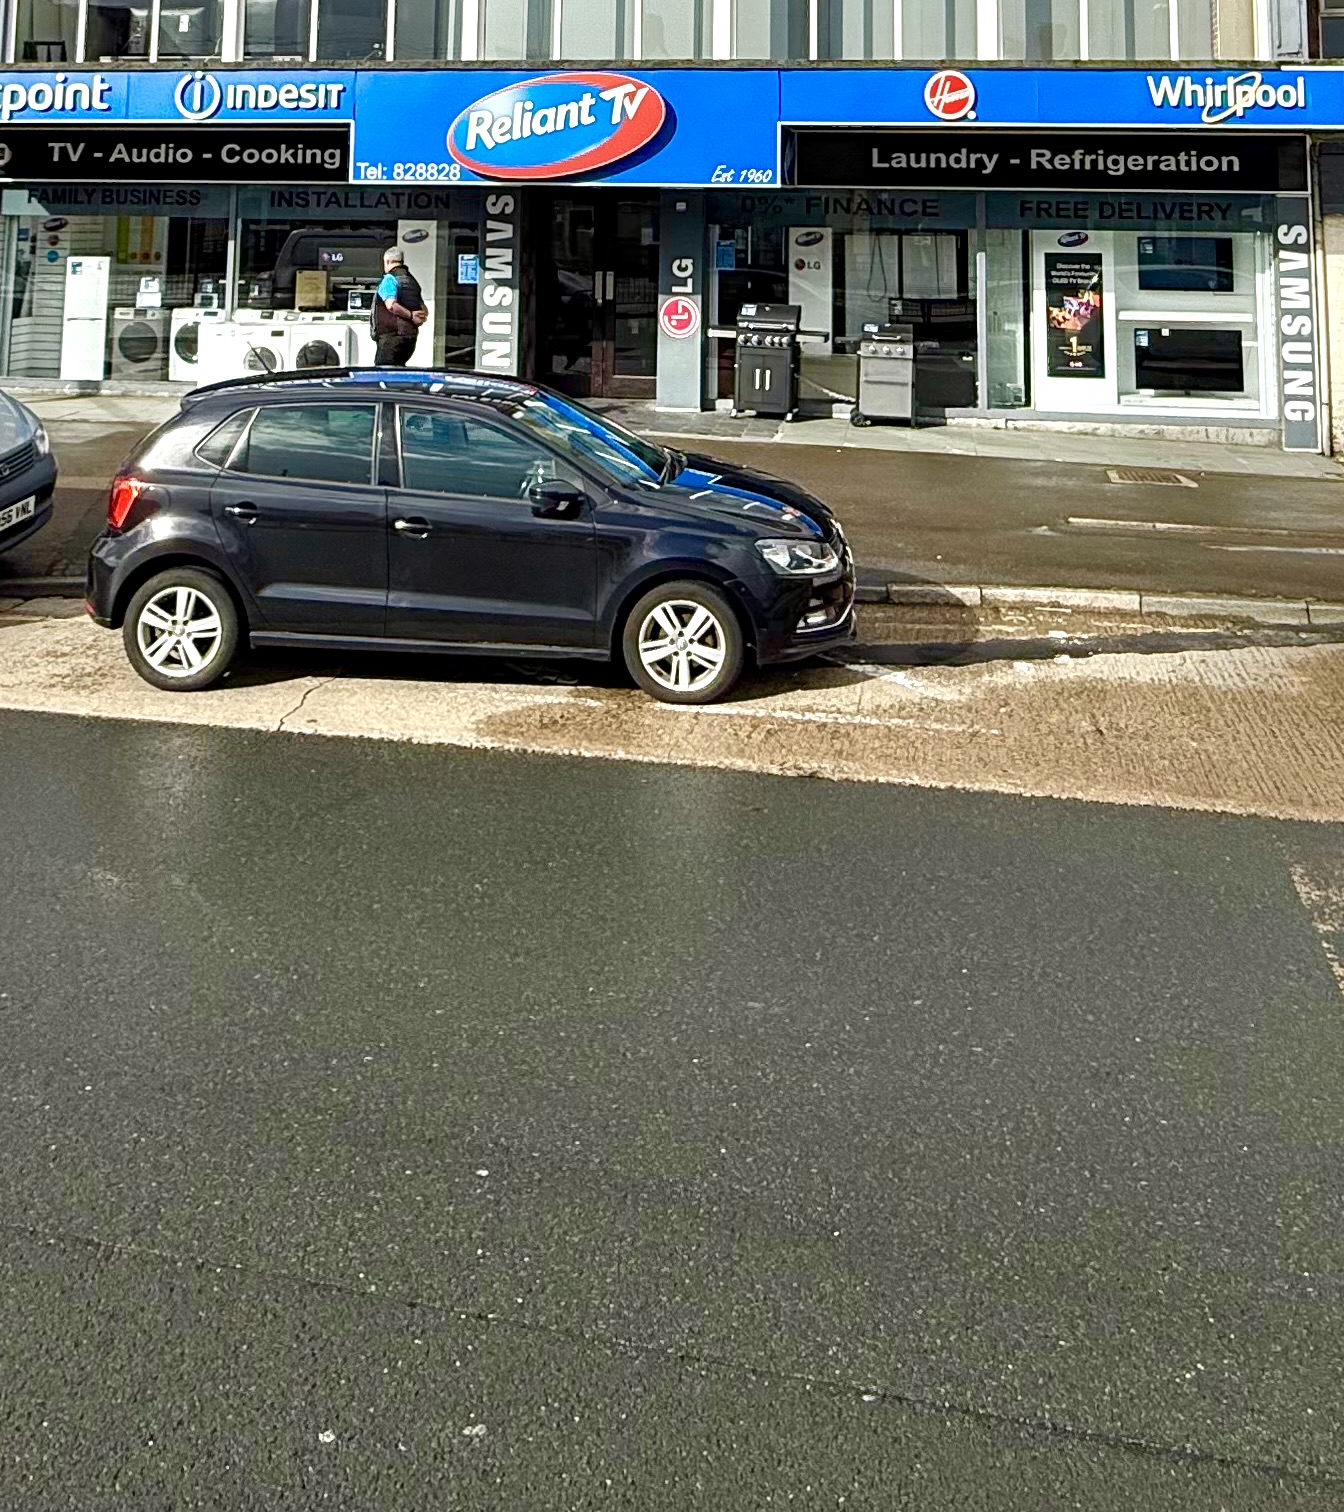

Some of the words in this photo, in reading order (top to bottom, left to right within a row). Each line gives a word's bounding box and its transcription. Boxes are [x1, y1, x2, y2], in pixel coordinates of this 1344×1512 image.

[1146, 74, 1305, 119] Whirlpool
[465, 92, 596, 151] Reliant
[48, 142, 85, 162] TV
[108, 143, 193, 163] Audio
[220, 143, 342, 169] Cooking
[871, 147, 999, 174] Laundry
[1030, 148, 1240, 176] Refrigeration
[357, 162, 388, 180] Tel:
[393, 163, 461, 181] 828828
[711, 165, 735, 183] Est
[739, 168, 773, 183] 1960
[27, 189, 101, 206] FAMILY
[105, 189, 201, 207] BUSINESS
[269, 190, 451, 210] INSTALLATION
[805, 196, 940, 217] FINANCE
[1019, 199, 1089, 220] FREE
[1098, 200, 1234, 221] DELIVERY
[331, 253, 344, 262] LG
[807, 261, 821, 270] LG
[481, 193, 515, 367] SAMSUN
[672, 258, 694, 293] LG
[1277, 223, 1316, 423] SAMSUNG
